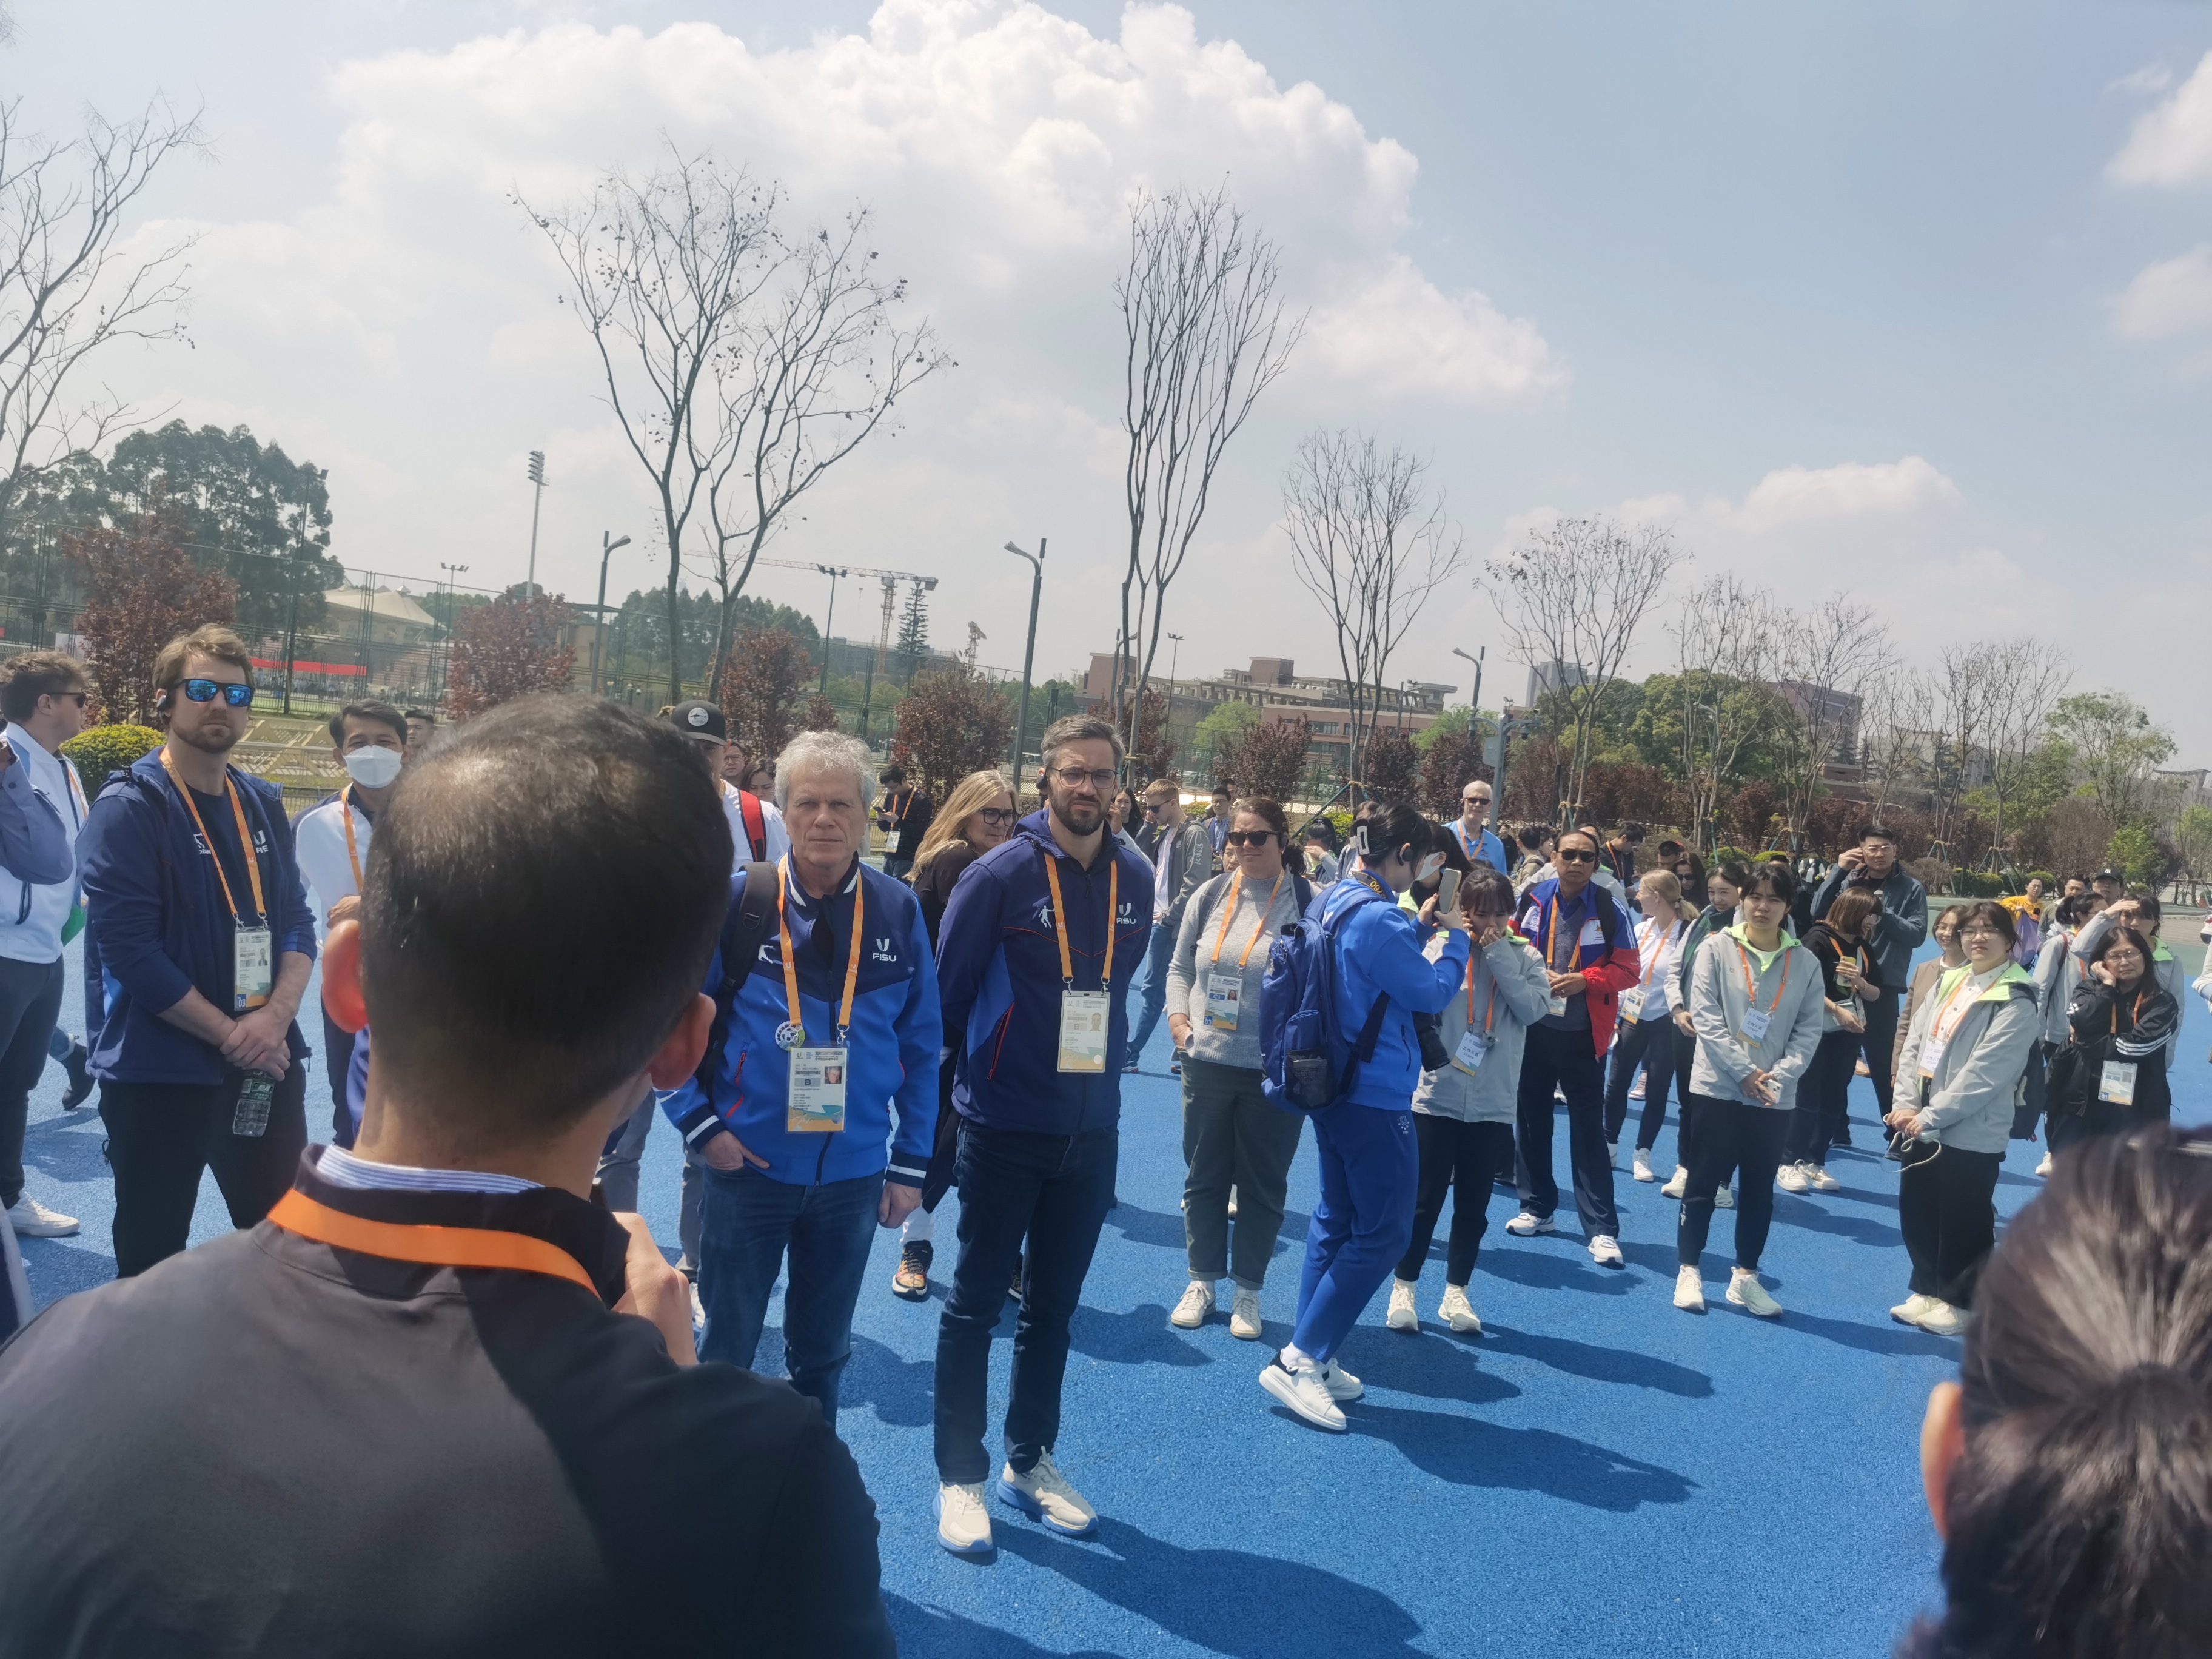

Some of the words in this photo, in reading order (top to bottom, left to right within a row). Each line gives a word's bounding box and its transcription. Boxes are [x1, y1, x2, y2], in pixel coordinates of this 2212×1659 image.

[873, 953, 897, 962] FISU
[1463, 1046, 1479, 1057] 工作人员
